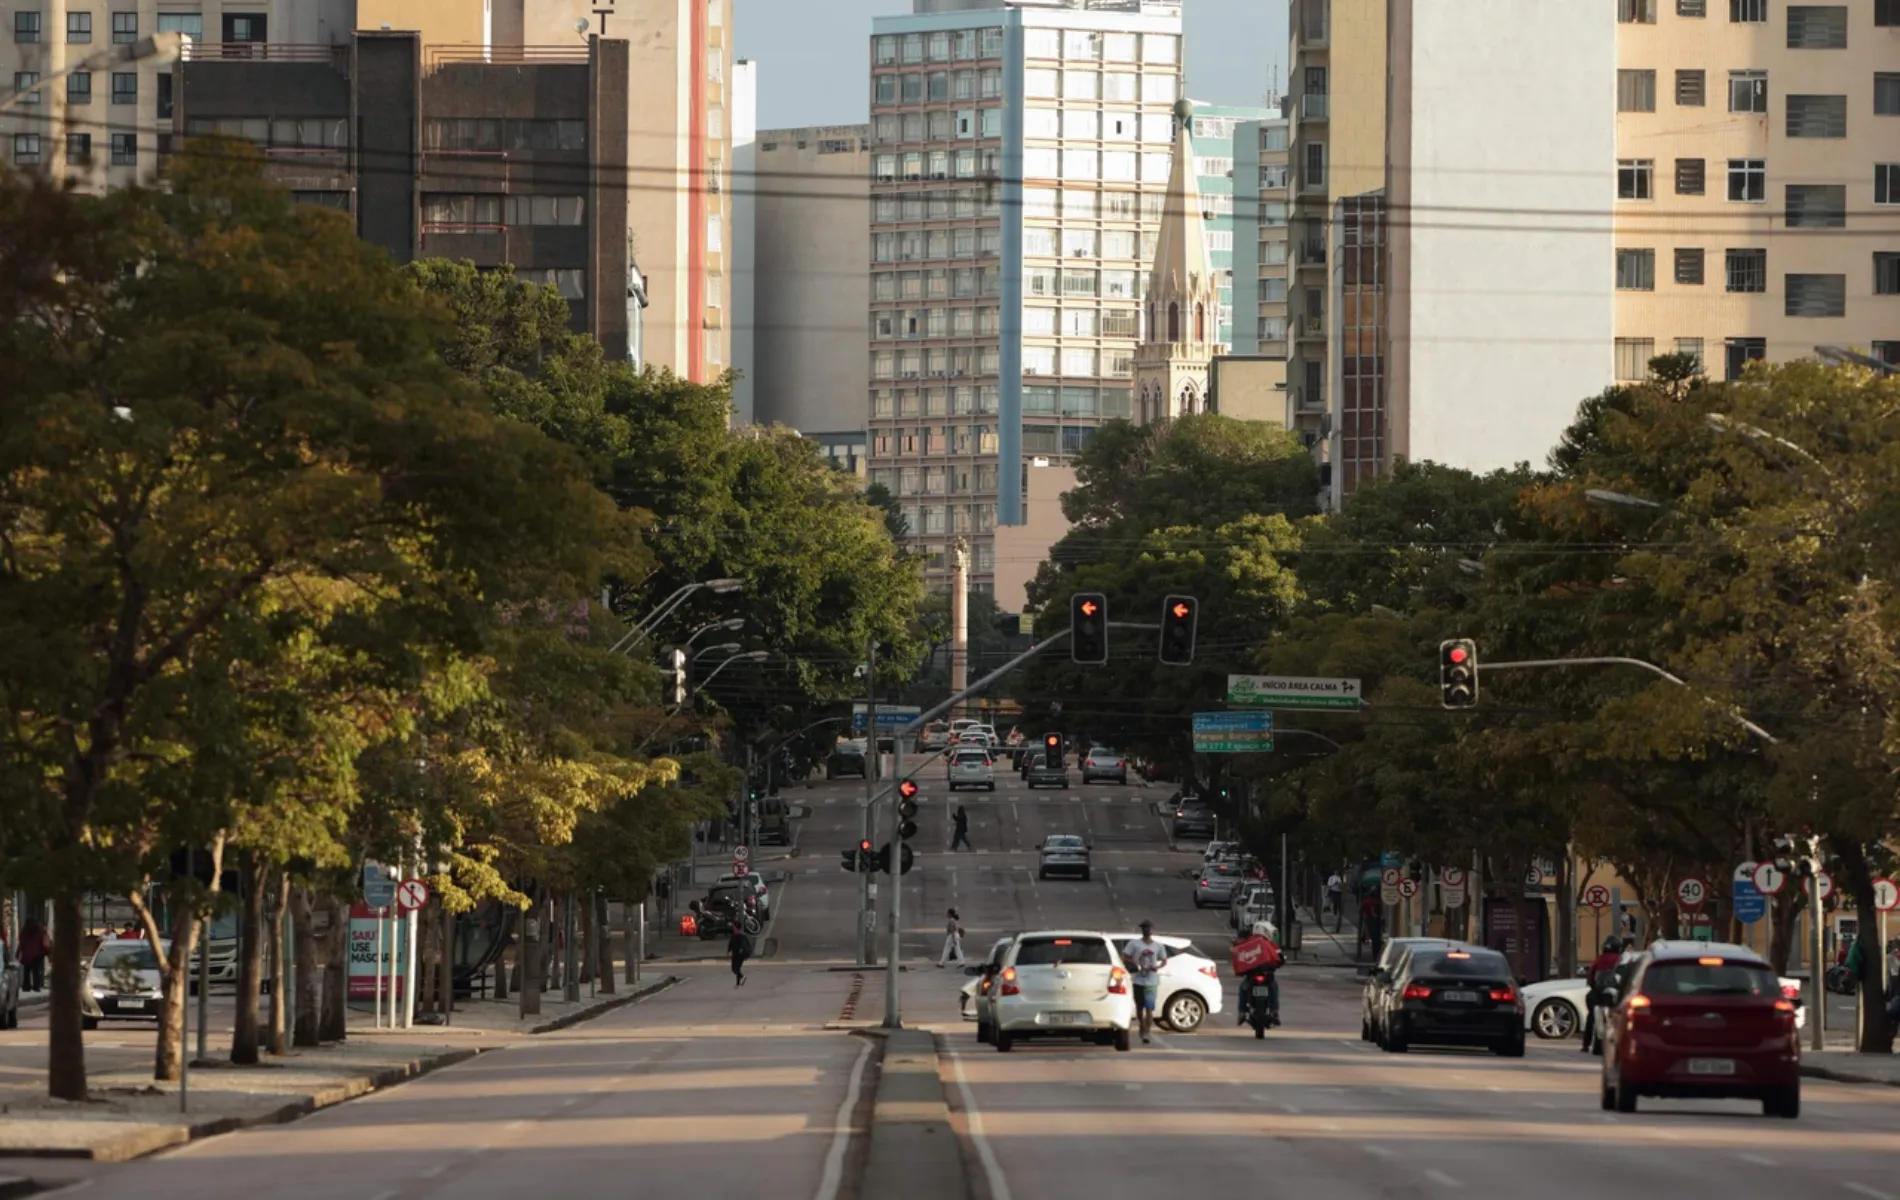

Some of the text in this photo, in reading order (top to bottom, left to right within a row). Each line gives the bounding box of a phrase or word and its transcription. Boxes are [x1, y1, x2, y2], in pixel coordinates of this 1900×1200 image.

[1262, 680, 1337, 691] INÍCIO ÁREA CALMA
[736, 847, 747, 856] 40
[1681, 883, 1701, 896] 40
[352, 931, 378, 940] SAIU
[352, 942, 370, 952] USE
[352, 952, 401, 963] MASCR!
